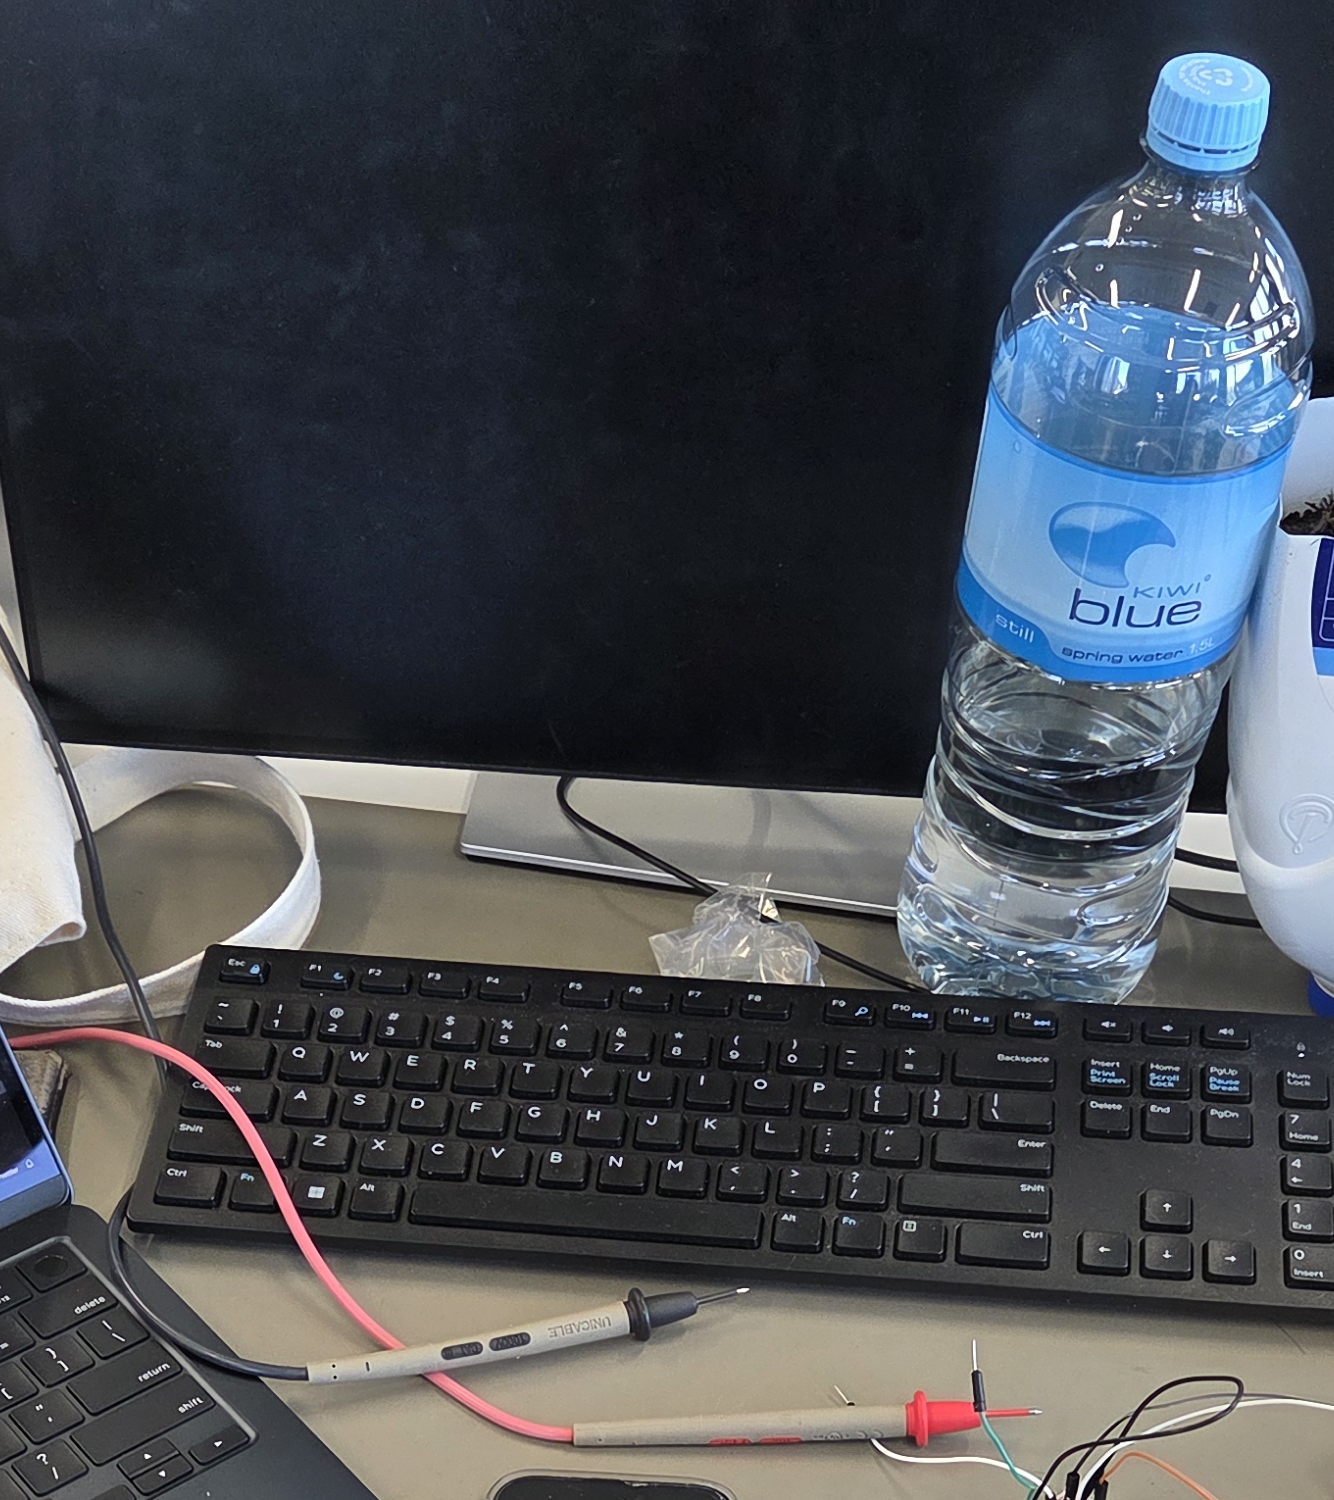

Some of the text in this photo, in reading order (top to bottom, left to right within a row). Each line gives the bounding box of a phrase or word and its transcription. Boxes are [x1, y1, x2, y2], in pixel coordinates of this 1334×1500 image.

[1069, 588, 1202, 628] blue
[995, 613, 1035, 644] still
[1188, 637, 1215, 656] 1.5L
[1062, 646, 1183, 664] spring water
[227, 958, 246, 968] Esc
[205, 1040, 223, 1049] Tab
[997, 1053, 1050, 1064] Backspace
[1091, 1058, 1119, 1068] Insert
[1150, 1063, 1180, 1073] Home
[1209, 1066, 1237, 1078] PgUp
[1090, 1070, 1116, 1080] Print
[1090, 1075, 1126, 1086] Screen
[1149, 1073, 1180, 1084] Scroll
[1091, 1101, 1123, 1112] Delete
[1150, 1105, 1170, 1114] End
[1210, 1109, 1239, 1120] PgDn
[179, 1124, 204, 1134] Shift
[1017, 1139, 1046, 1149] Enter
[1022, 1230, 1044, 1240] Ctrl
[1293, 1269, 1323, 1280] Insert
[74, 1295, 107, 1316] delete
[548, 1316, 611, 1338] UNICABLE
[137, 1362, 170, 1384] return
[177, 1395, 204, 1415] shift
